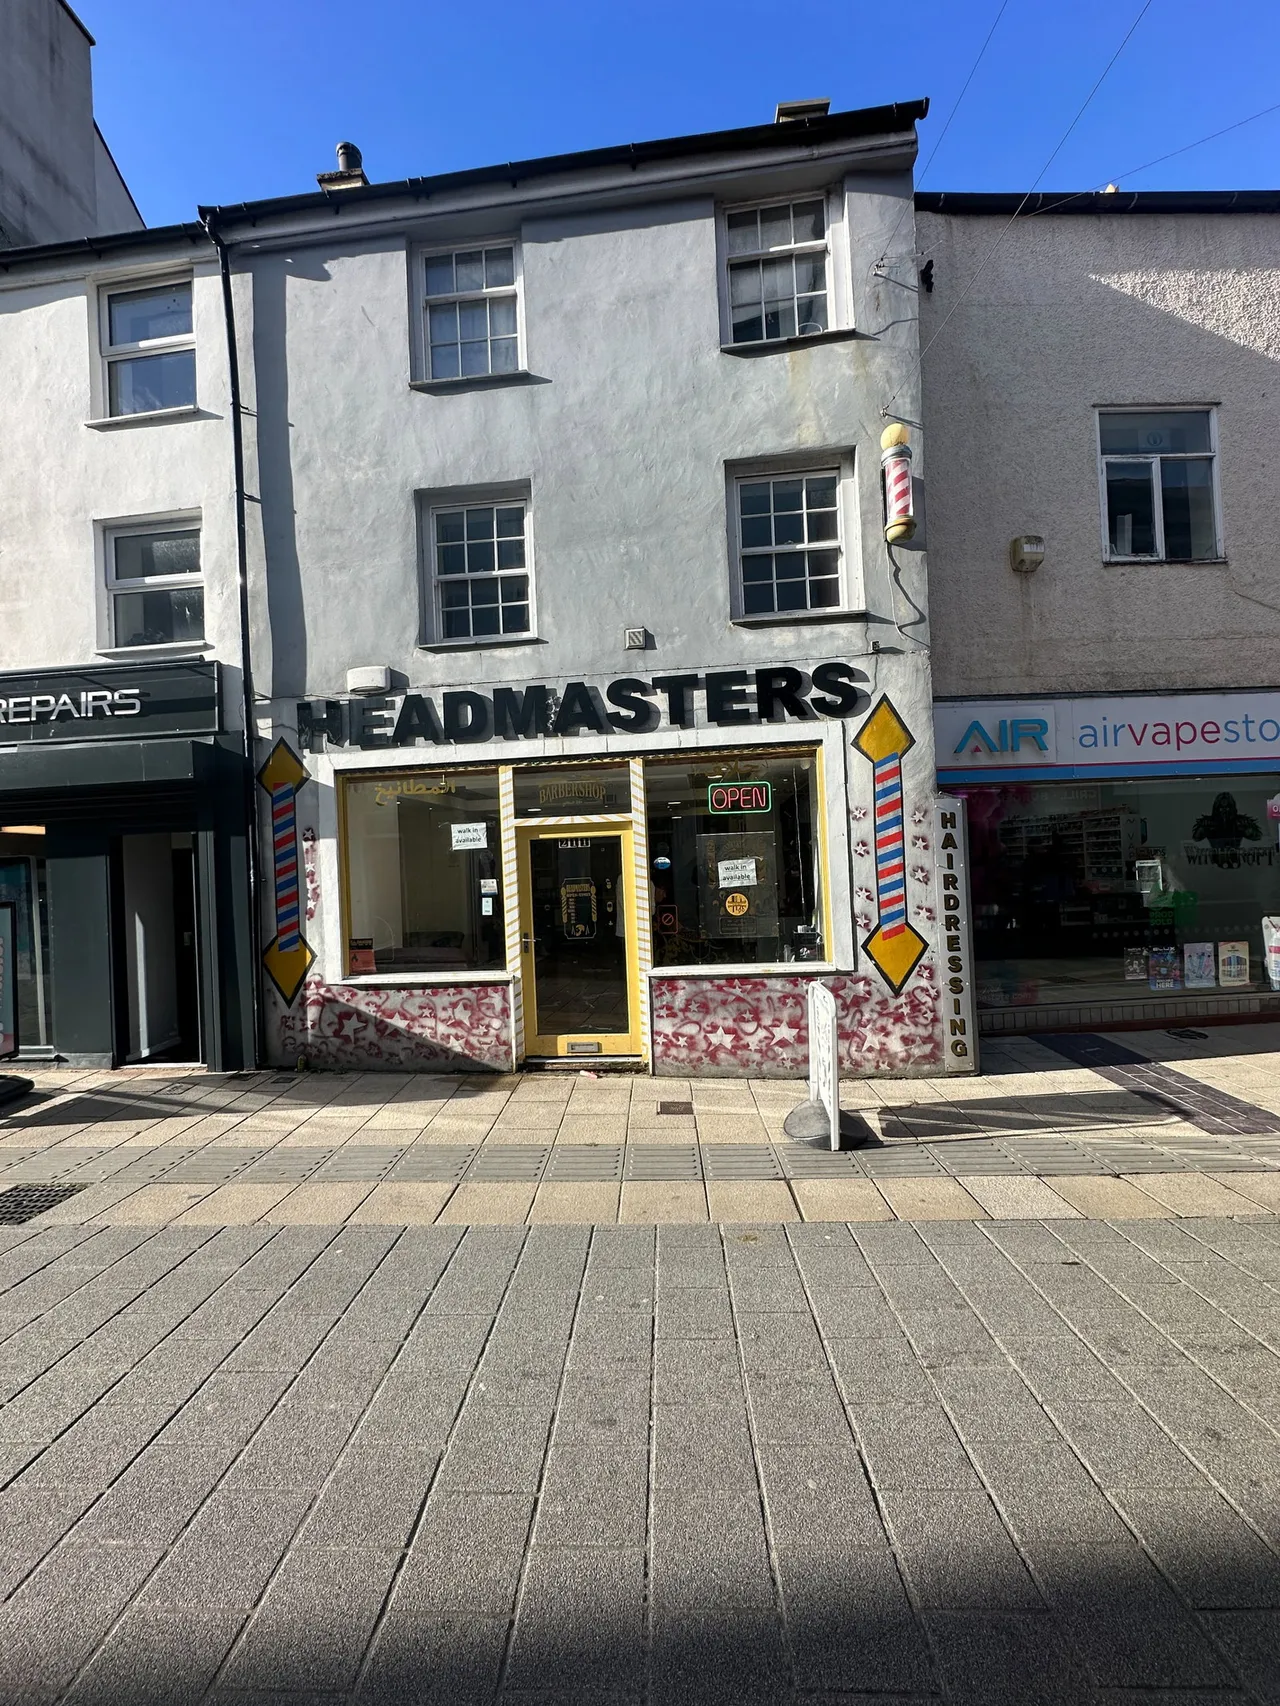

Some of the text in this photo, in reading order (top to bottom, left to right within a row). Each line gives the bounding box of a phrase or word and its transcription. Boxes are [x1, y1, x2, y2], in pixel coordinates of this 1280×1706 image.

[0, 688, 141, 724] EPAIRS
[297, 662, 861, 748] HEADMASTERS
[954, 717, 1049, 753] AIR
[540, 781, 606, 803] BARBERSHOP
[712, 786, 766, 809] OPEN
[561, 838, 588, 847] 211
[940, 811, 968, 1058] HAIRDRESSING
